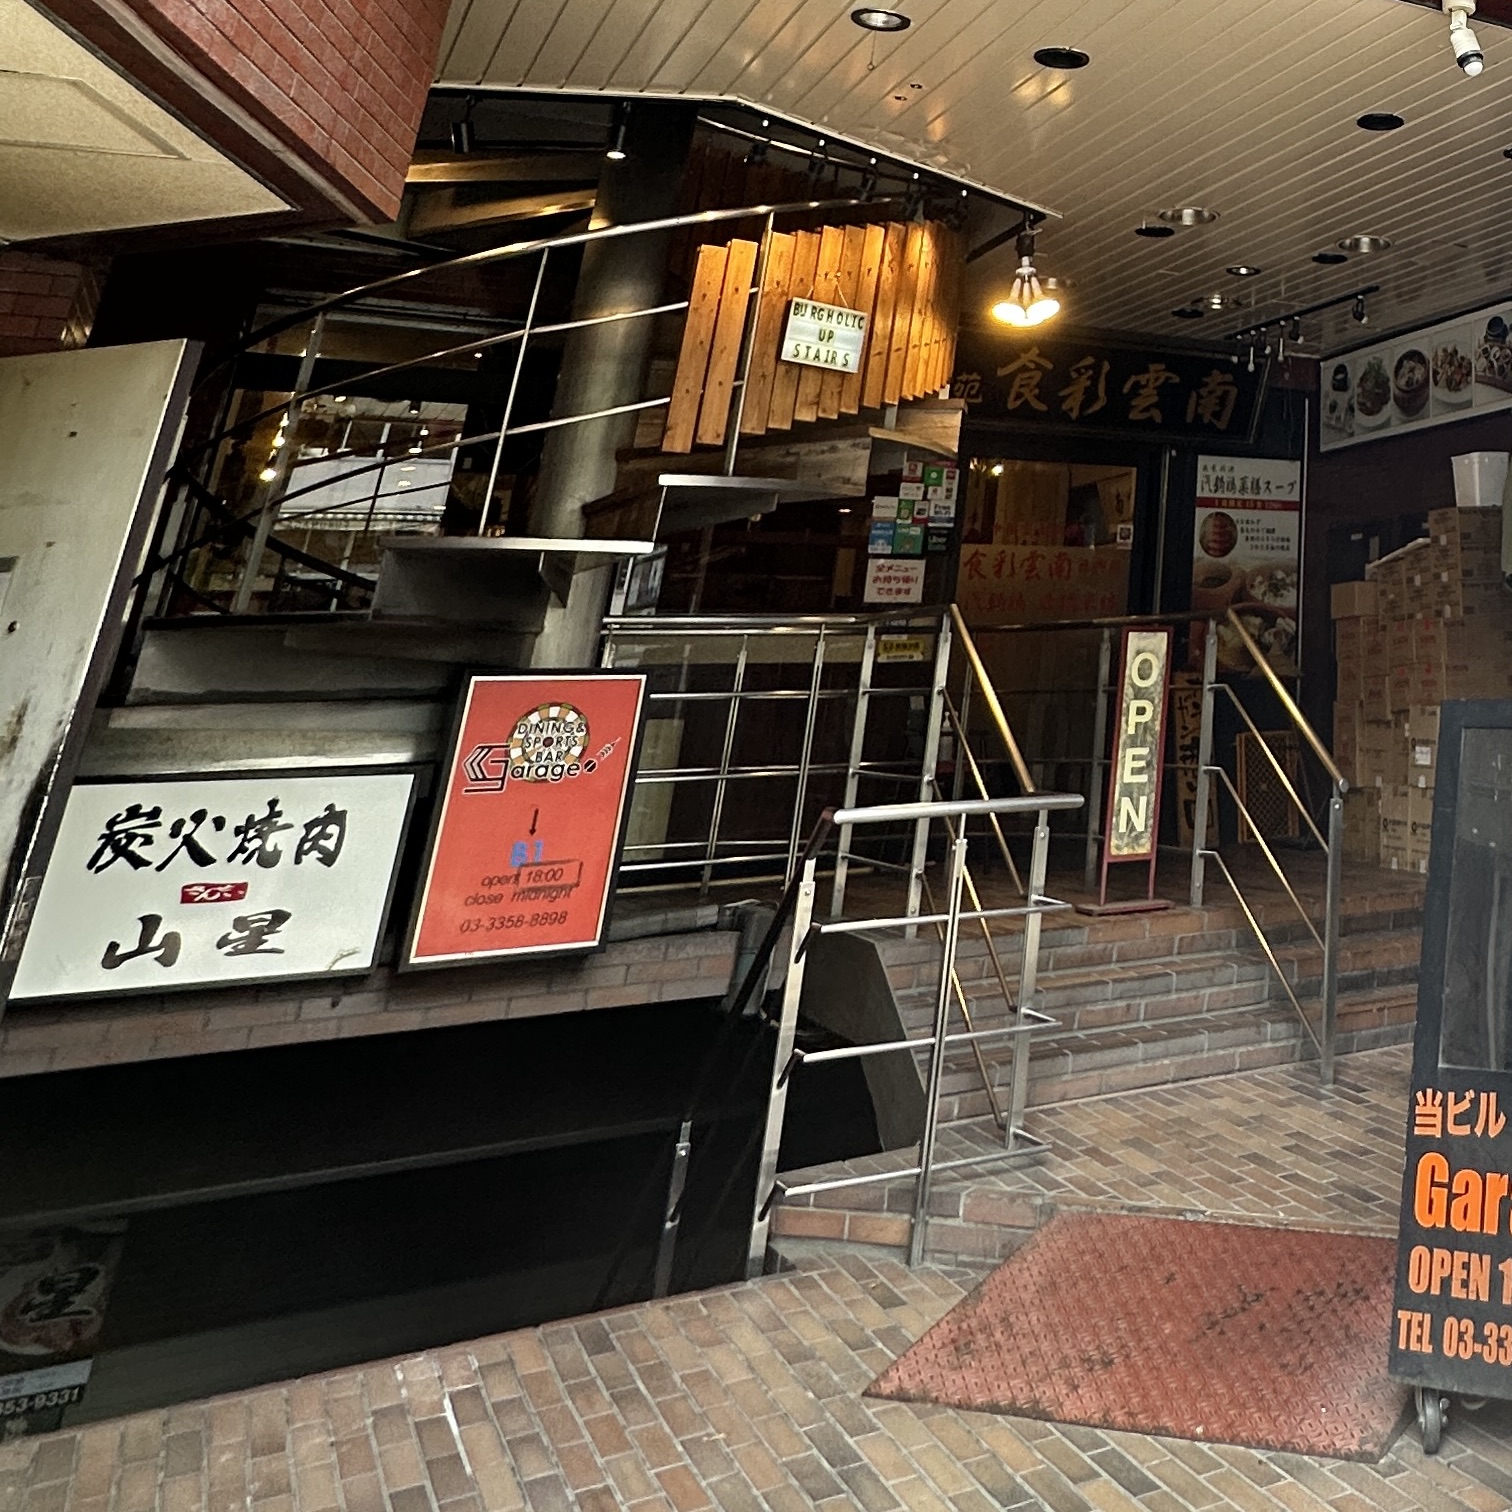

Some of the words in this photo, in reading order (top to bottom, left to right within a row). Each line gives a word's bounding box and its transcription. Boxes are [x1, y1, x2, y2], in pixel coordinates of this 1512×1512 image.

[792, 343, 850, 368] STAIRS
[818, 328, 835, 344] UP
[997, 346, 1239, 430] 食彩雲南
[535, 750, 564, 764] BAR
[1117, 652, 1160, 834] OPEN
[86, 796, 350, 875] 炭火焼肉
[526, 867, 564, 884] 18:00
[464, 891, 504, 907] close
[101, 909, 293, 970] 山星
[460, 910, 569, 935] 03-3358-8898
[1414, 1088, 1507, 1139] 当ビル
[1408, 1245, 1489, 1304] OPEN
[1397, 1310, 1434, 1354] TEL
